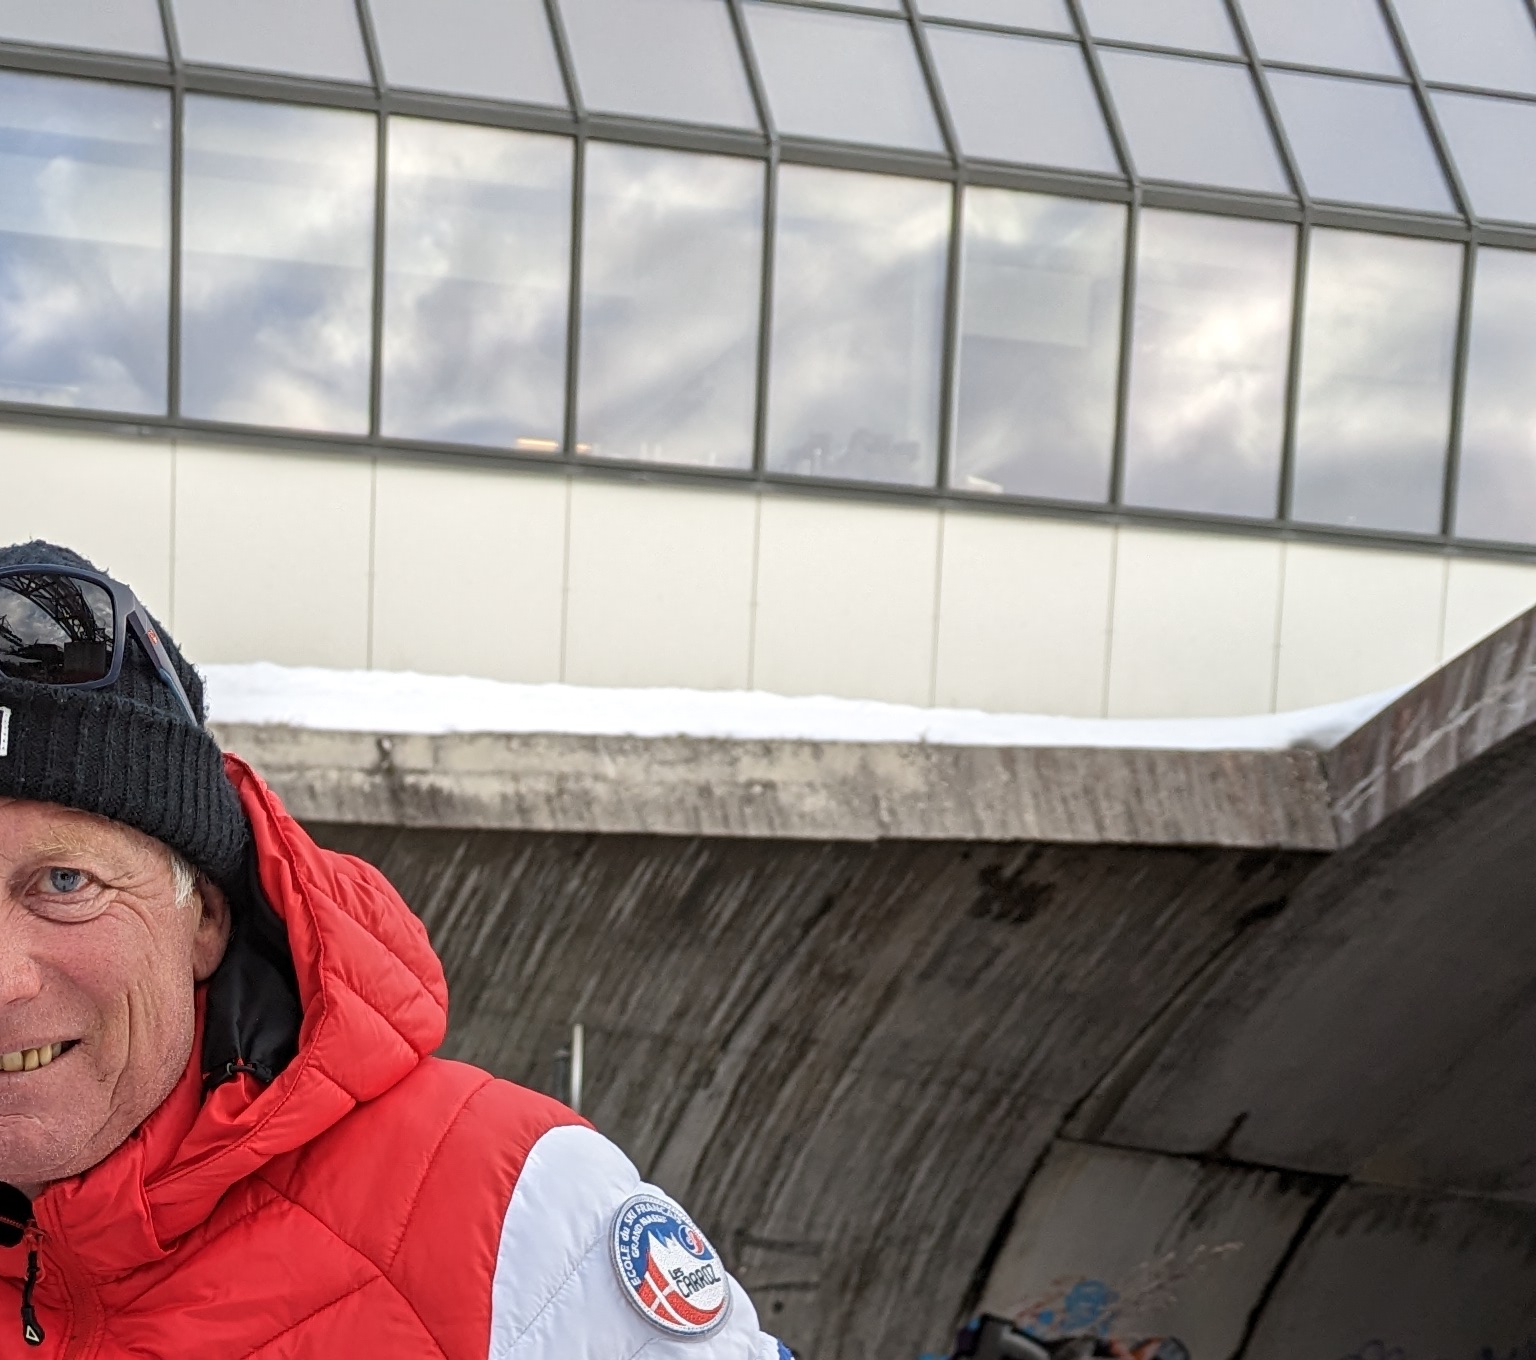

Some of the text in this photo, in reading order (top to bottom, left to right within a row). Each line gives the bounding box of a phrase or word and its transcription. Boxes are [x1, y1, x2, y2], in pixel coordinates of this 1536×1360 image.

[624, 1208, 637, 1227] SKI
[631, 1223, 644, 1258] GRAND
[620, 1244, 642, 1287] ECOLE
[675, 1263, 722, 1299] CARROZ
